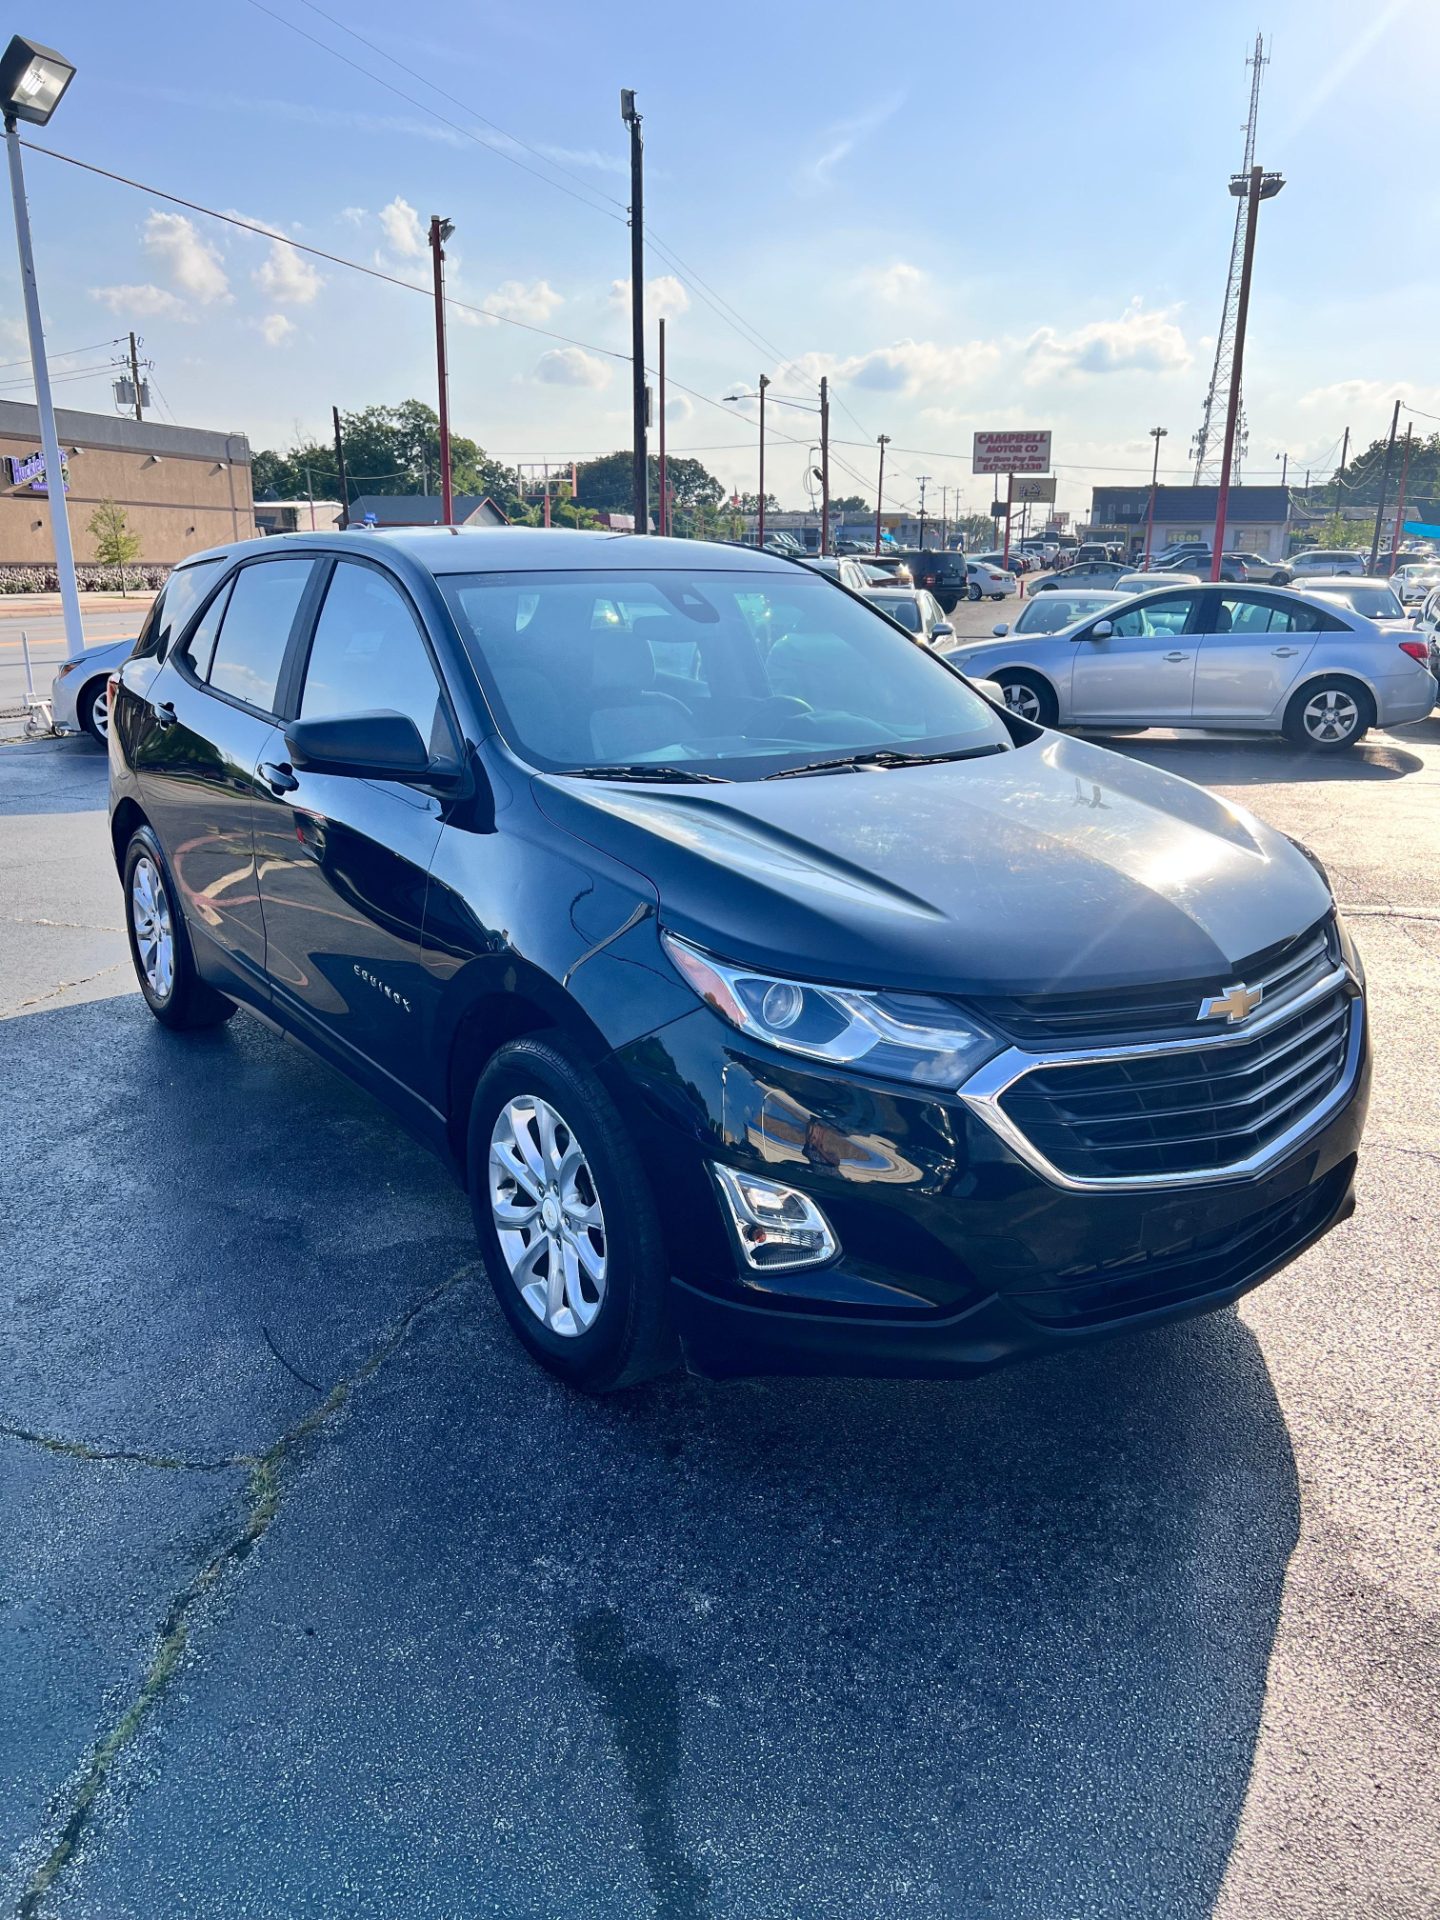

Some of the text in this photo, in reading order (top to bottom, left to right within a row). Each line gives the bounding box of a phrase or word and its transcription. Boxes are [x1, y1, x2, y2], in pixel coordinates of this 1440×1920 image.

[977, 433, 1047, 444] CAMPBELL
[985, 445, 1023, 453] MOTOR
[353, 964, 411, 1013] EQUINOX
